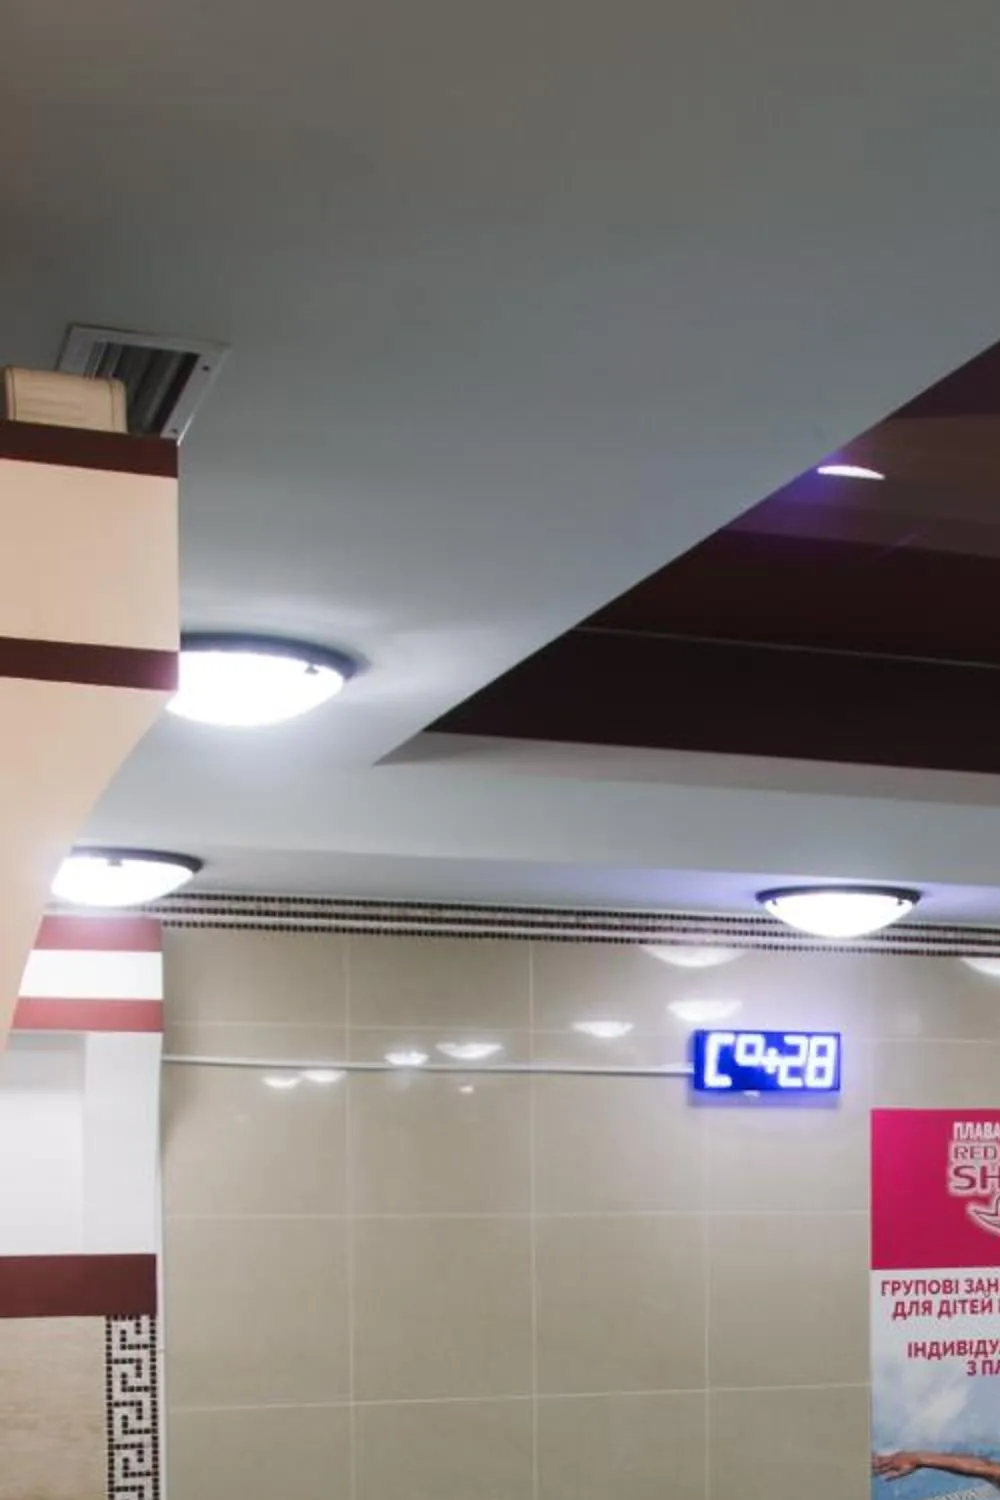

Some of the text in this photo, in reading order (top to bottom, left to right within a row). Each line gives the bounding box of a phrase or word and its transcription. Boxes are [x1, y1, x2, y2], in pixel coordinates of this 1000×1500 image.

[953, 1145, 998, 1160] RED
[881, 1280, 959, 1296] ГРУПОВІ
[892, 1300, 933, 1320] ДЛЯ
[938, 1294, 993, 1318] ДІТЕЙ
